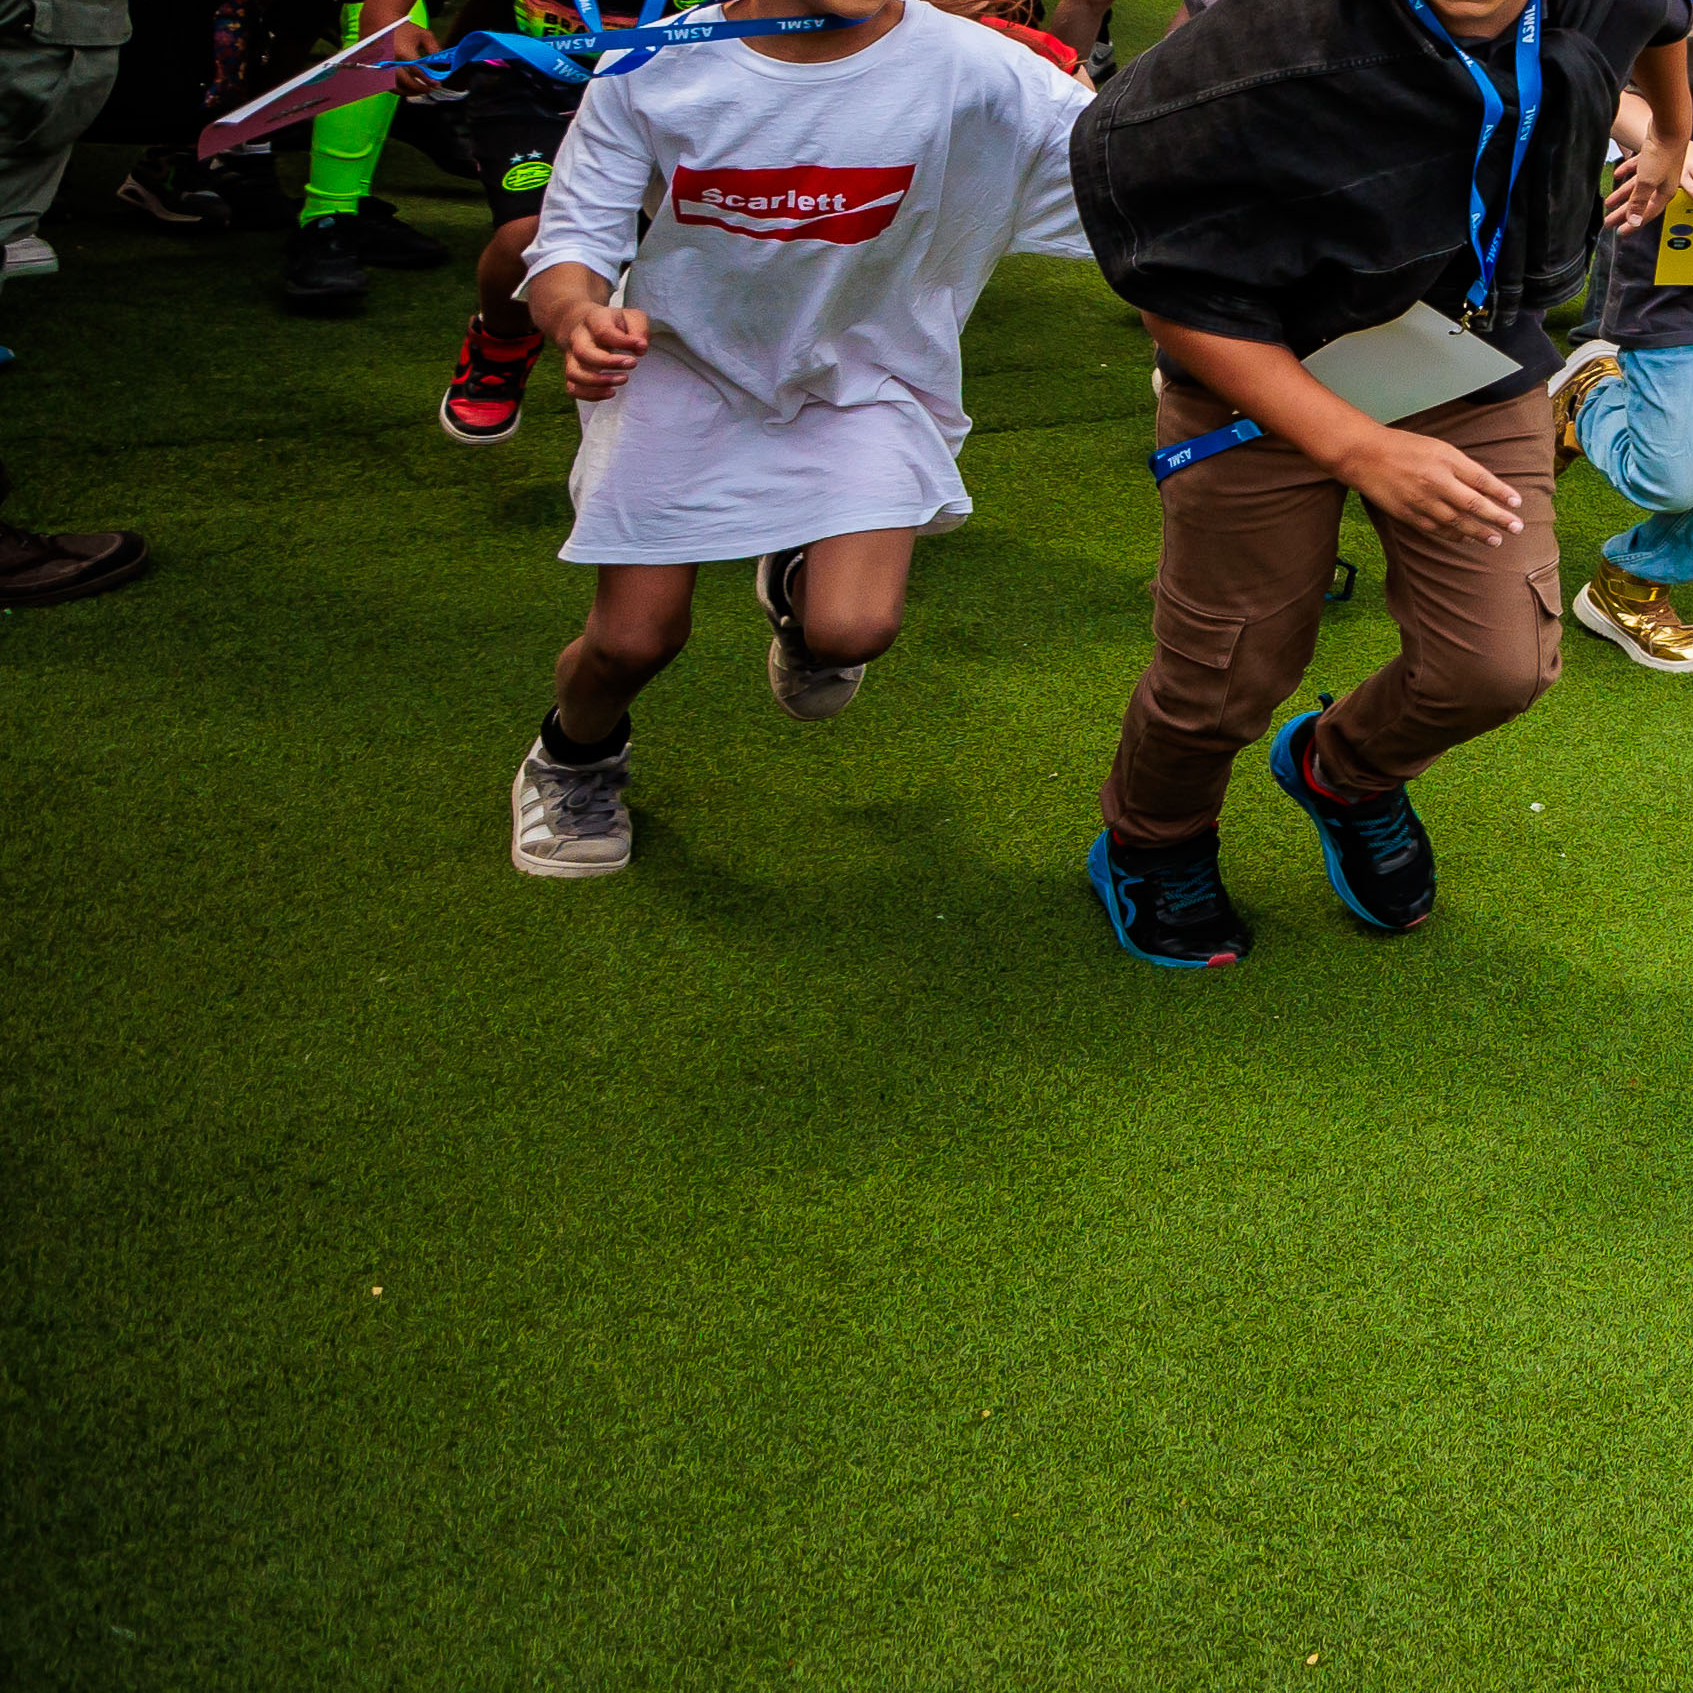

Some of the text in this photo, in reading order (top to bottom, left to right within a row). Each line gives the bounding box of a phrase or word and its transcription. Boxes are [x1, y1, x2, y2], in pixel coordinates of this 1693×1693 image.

[664, 26, 714, 41] ASML
[777, 18, 825, 32] ASML
[1522, 4, 1536, 43] ASML
[1520, 104, 1537, 141] ASML
[701, 188, 847, 212] Scarlett
[1167, 447, 1191, 468] ASML
